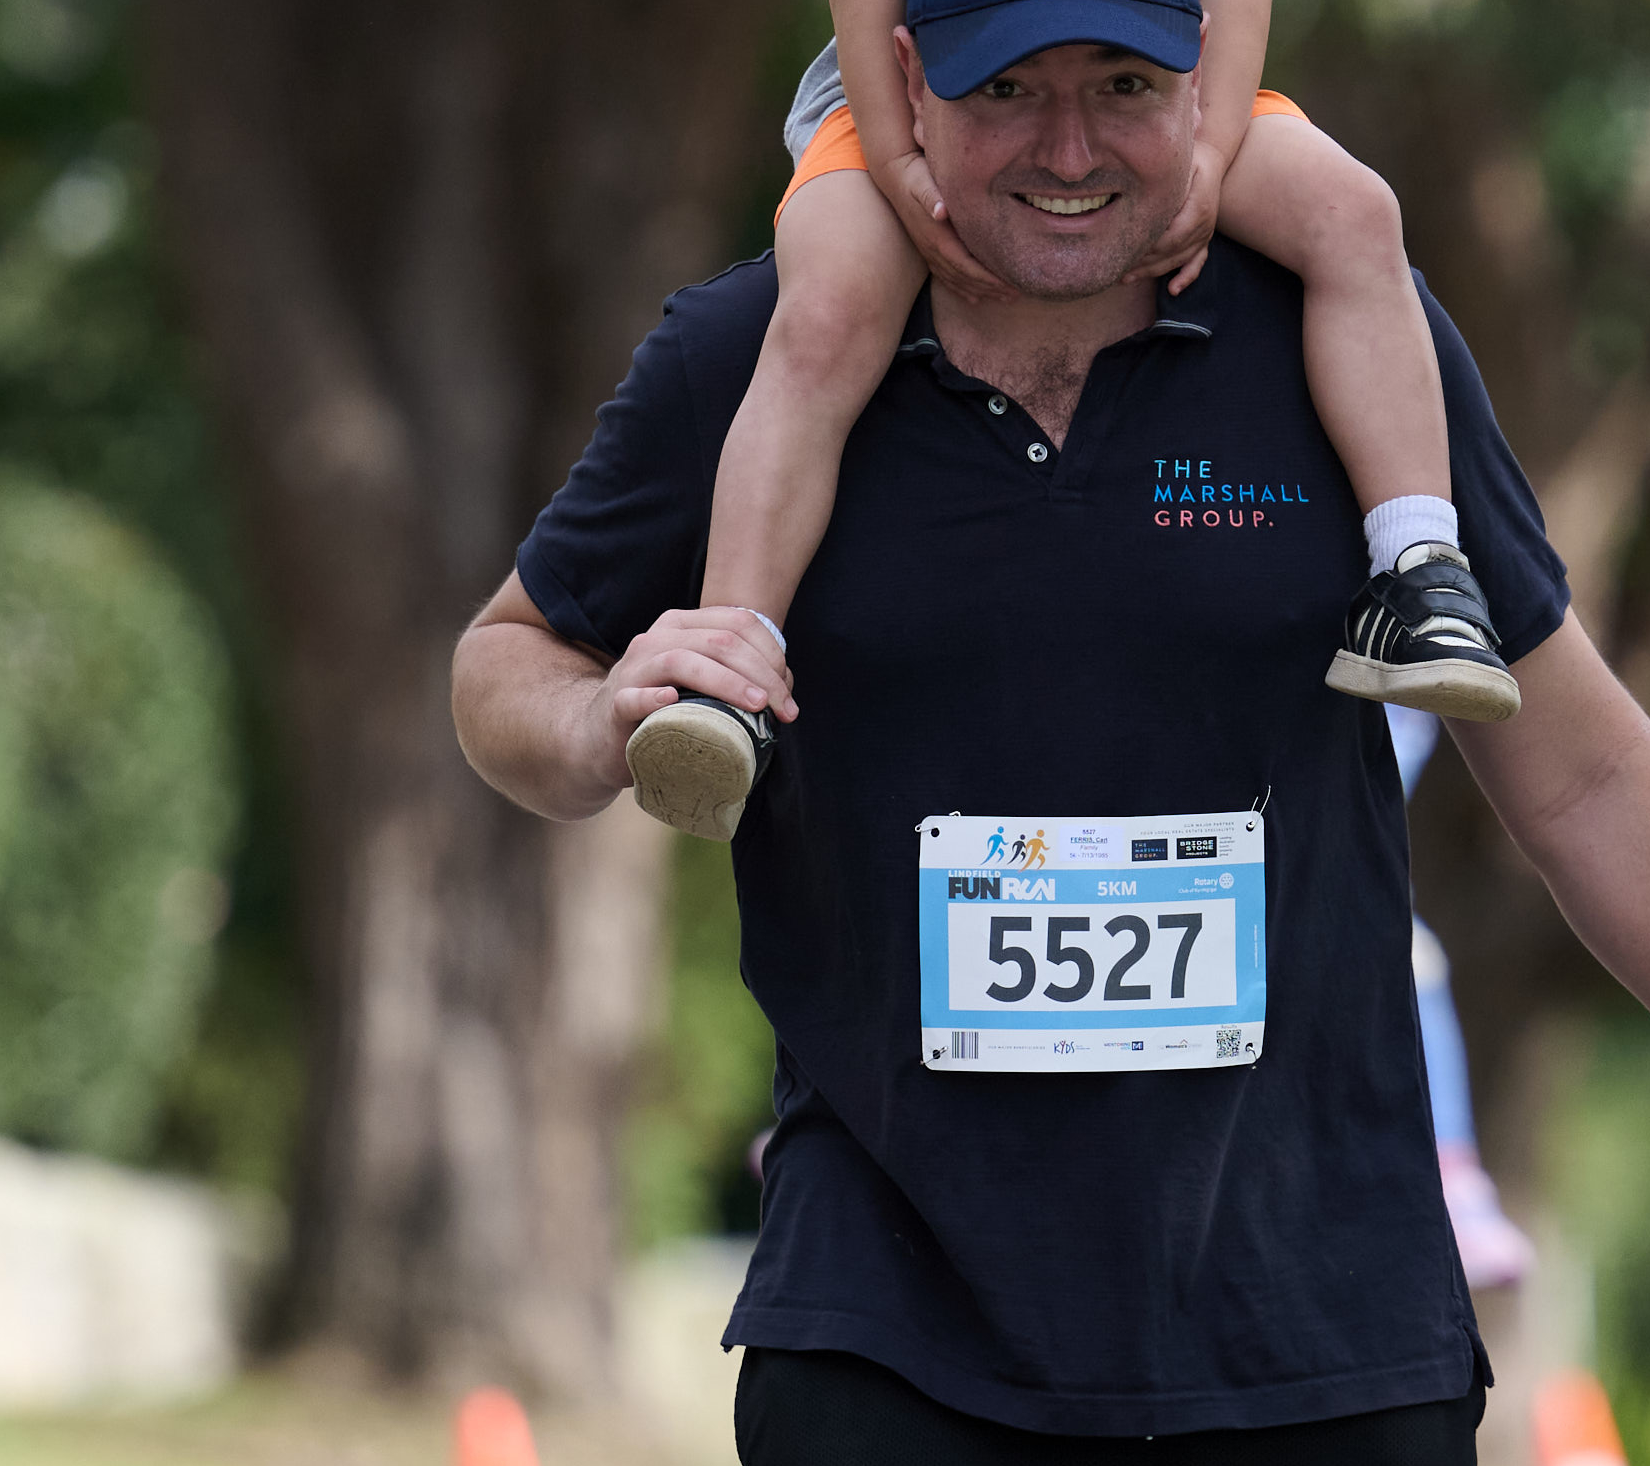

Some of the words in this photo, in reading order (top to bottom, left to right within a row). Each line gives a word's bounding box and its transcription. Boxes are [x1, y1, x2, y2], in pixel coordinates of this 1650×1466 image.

[1153, 459, 1212, 479] THE
[1153, 484, 1310, 503] MARSHALL
[1153, 509, 1275, 528] GROUP.
[1179, 839, 1214, 847] BRIDGE
[947, 869, 1002, 878] LINDFIELD
[1194, 877, 1219, 886] Rotary
[1097, 880, 1137, 897] 5KM
[984, 912, 1203, 1003] 5527
